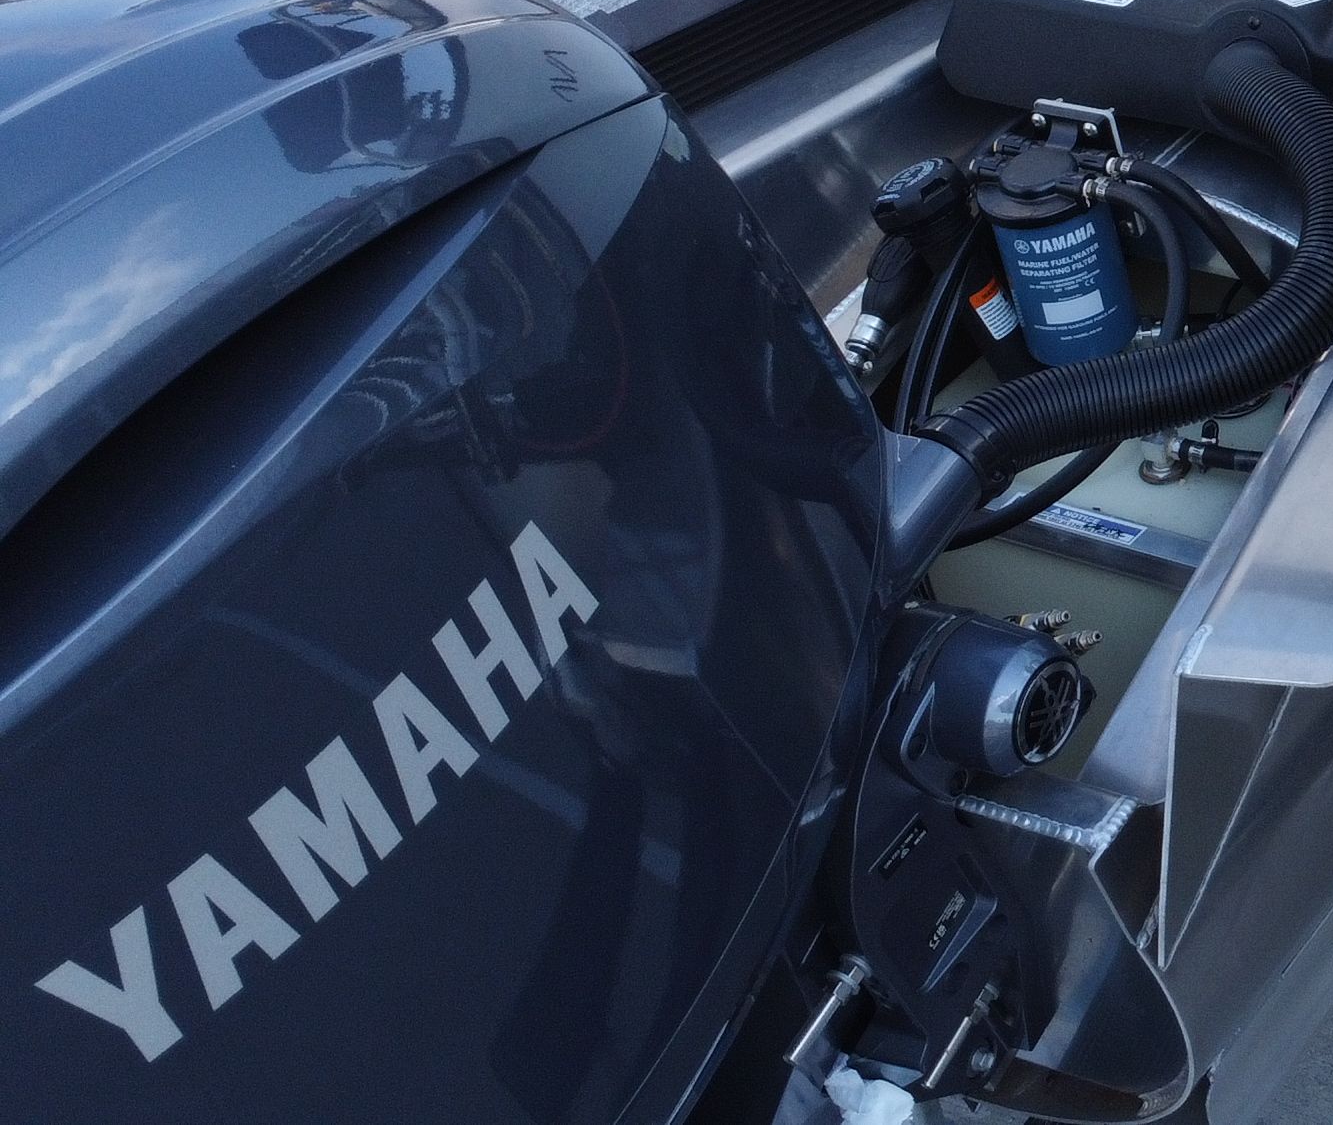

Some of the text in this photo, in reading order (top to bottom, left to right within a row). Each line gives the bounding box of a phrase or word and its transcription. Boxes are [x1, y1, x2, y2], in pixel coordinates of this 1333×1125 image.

[1030, 222, 1096, 254] YAMAHA
[1018, 260, 1050, 269] MARINE
[1020, 254, 1098, 277] SEPARATING FILTER
[1063, 510, 1102, 525] NOTICE
[34, 520, 600, 1063] YAMAHA
